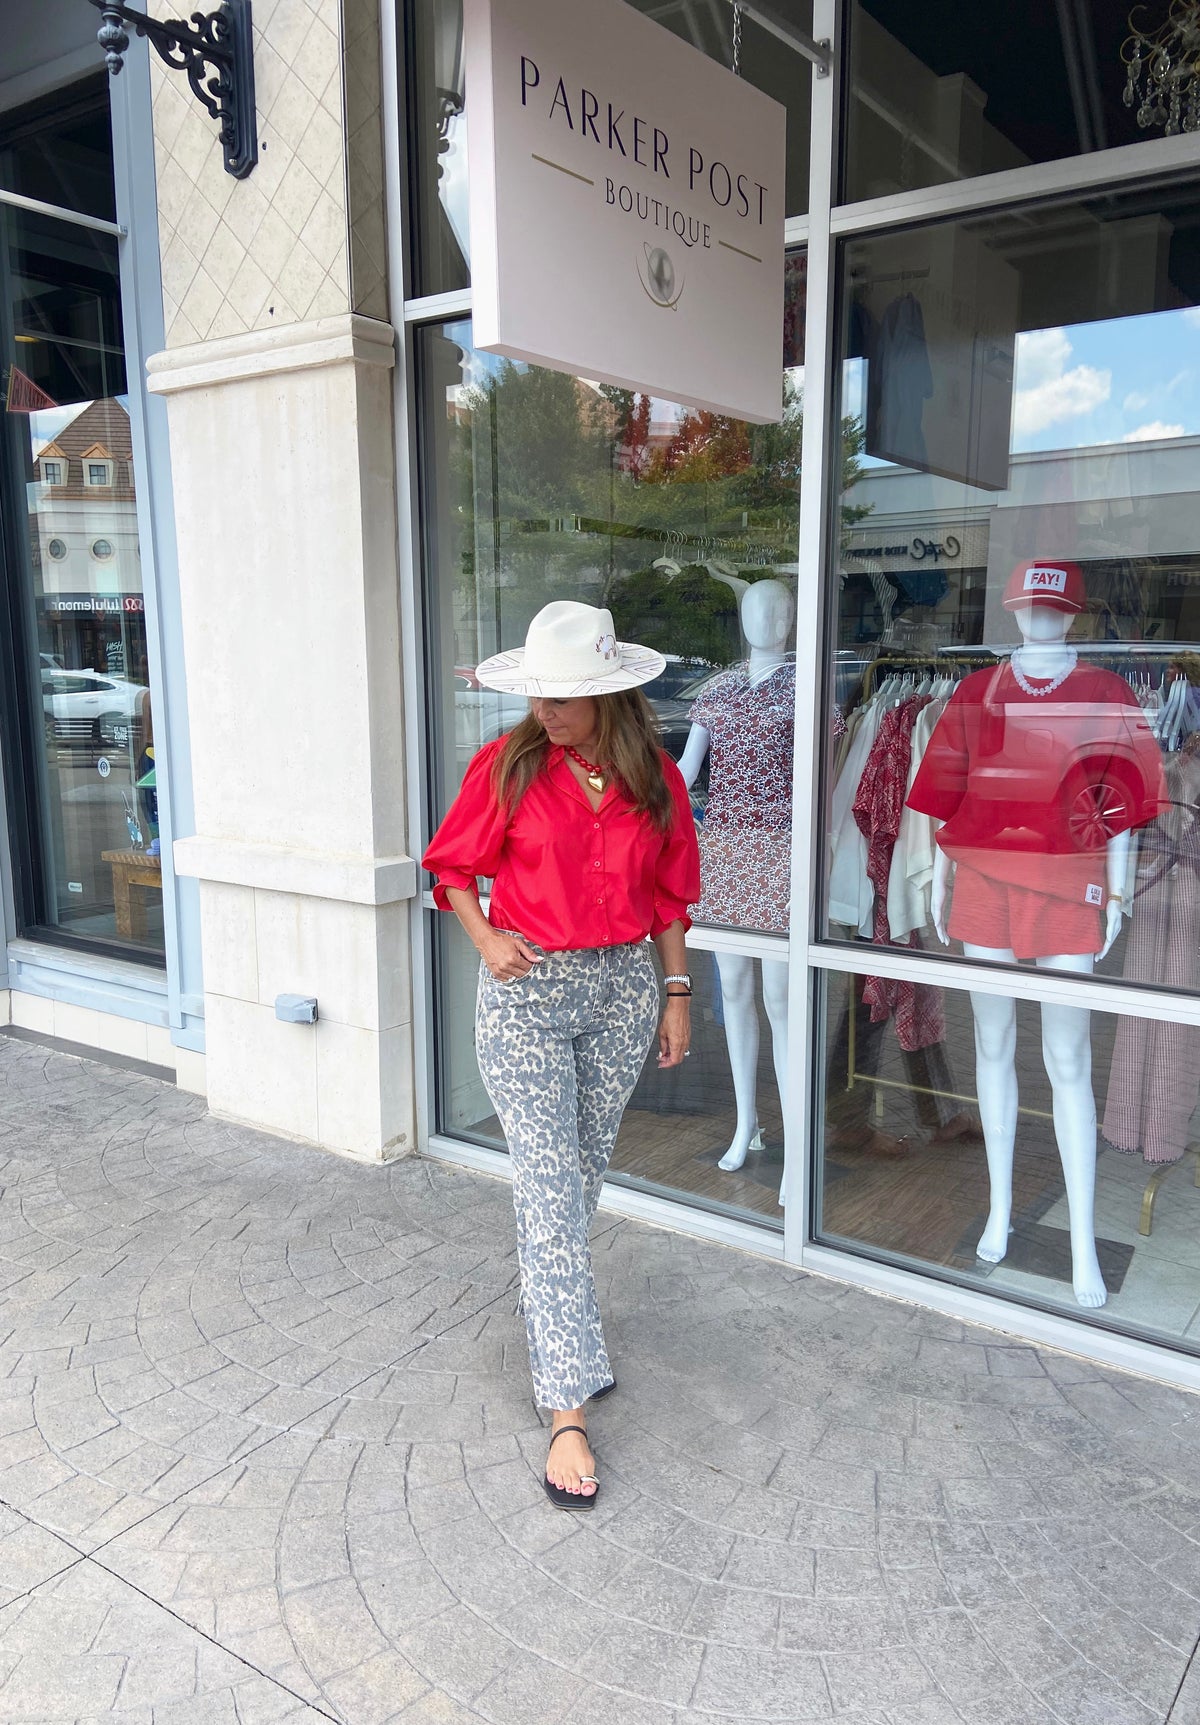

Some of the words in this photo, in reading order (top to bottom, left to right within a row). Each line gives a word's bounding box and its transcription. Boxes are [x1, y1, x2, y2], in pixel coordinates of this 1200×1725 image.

[520, 55, 670, 179] PARKER
[689, 147, 769, 225] POST
[605, 177, 711, 249] BOUTIQUE
[1030, 572, 1060, 586] FAY!
